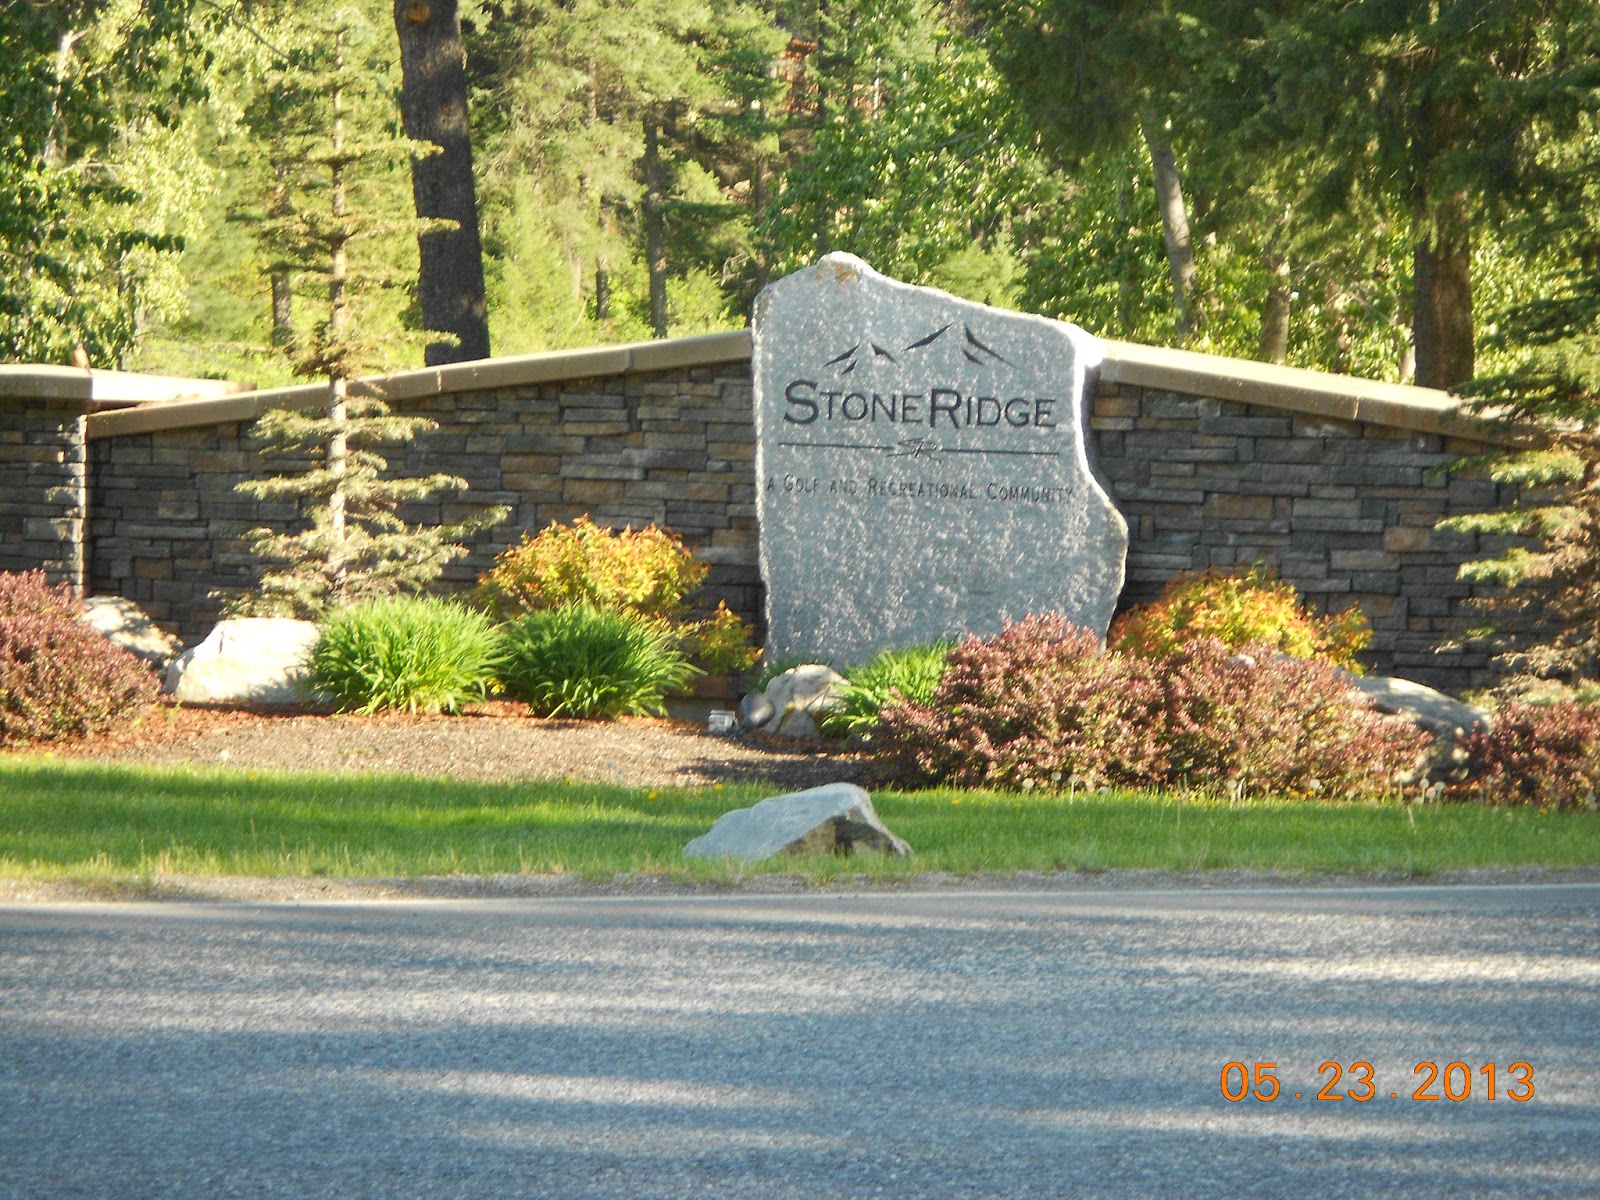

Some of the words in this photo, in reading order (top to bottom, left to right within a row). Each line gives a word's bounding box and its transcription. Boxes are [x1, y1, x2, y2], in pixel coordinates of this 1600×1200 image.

[783, 473, 819, 493] GOLF
[829, 478, 858, 496] AND
[867, 476, 977, 499] RECREATIONAL
[986, 482, 1074, 503] COMMUNITY
